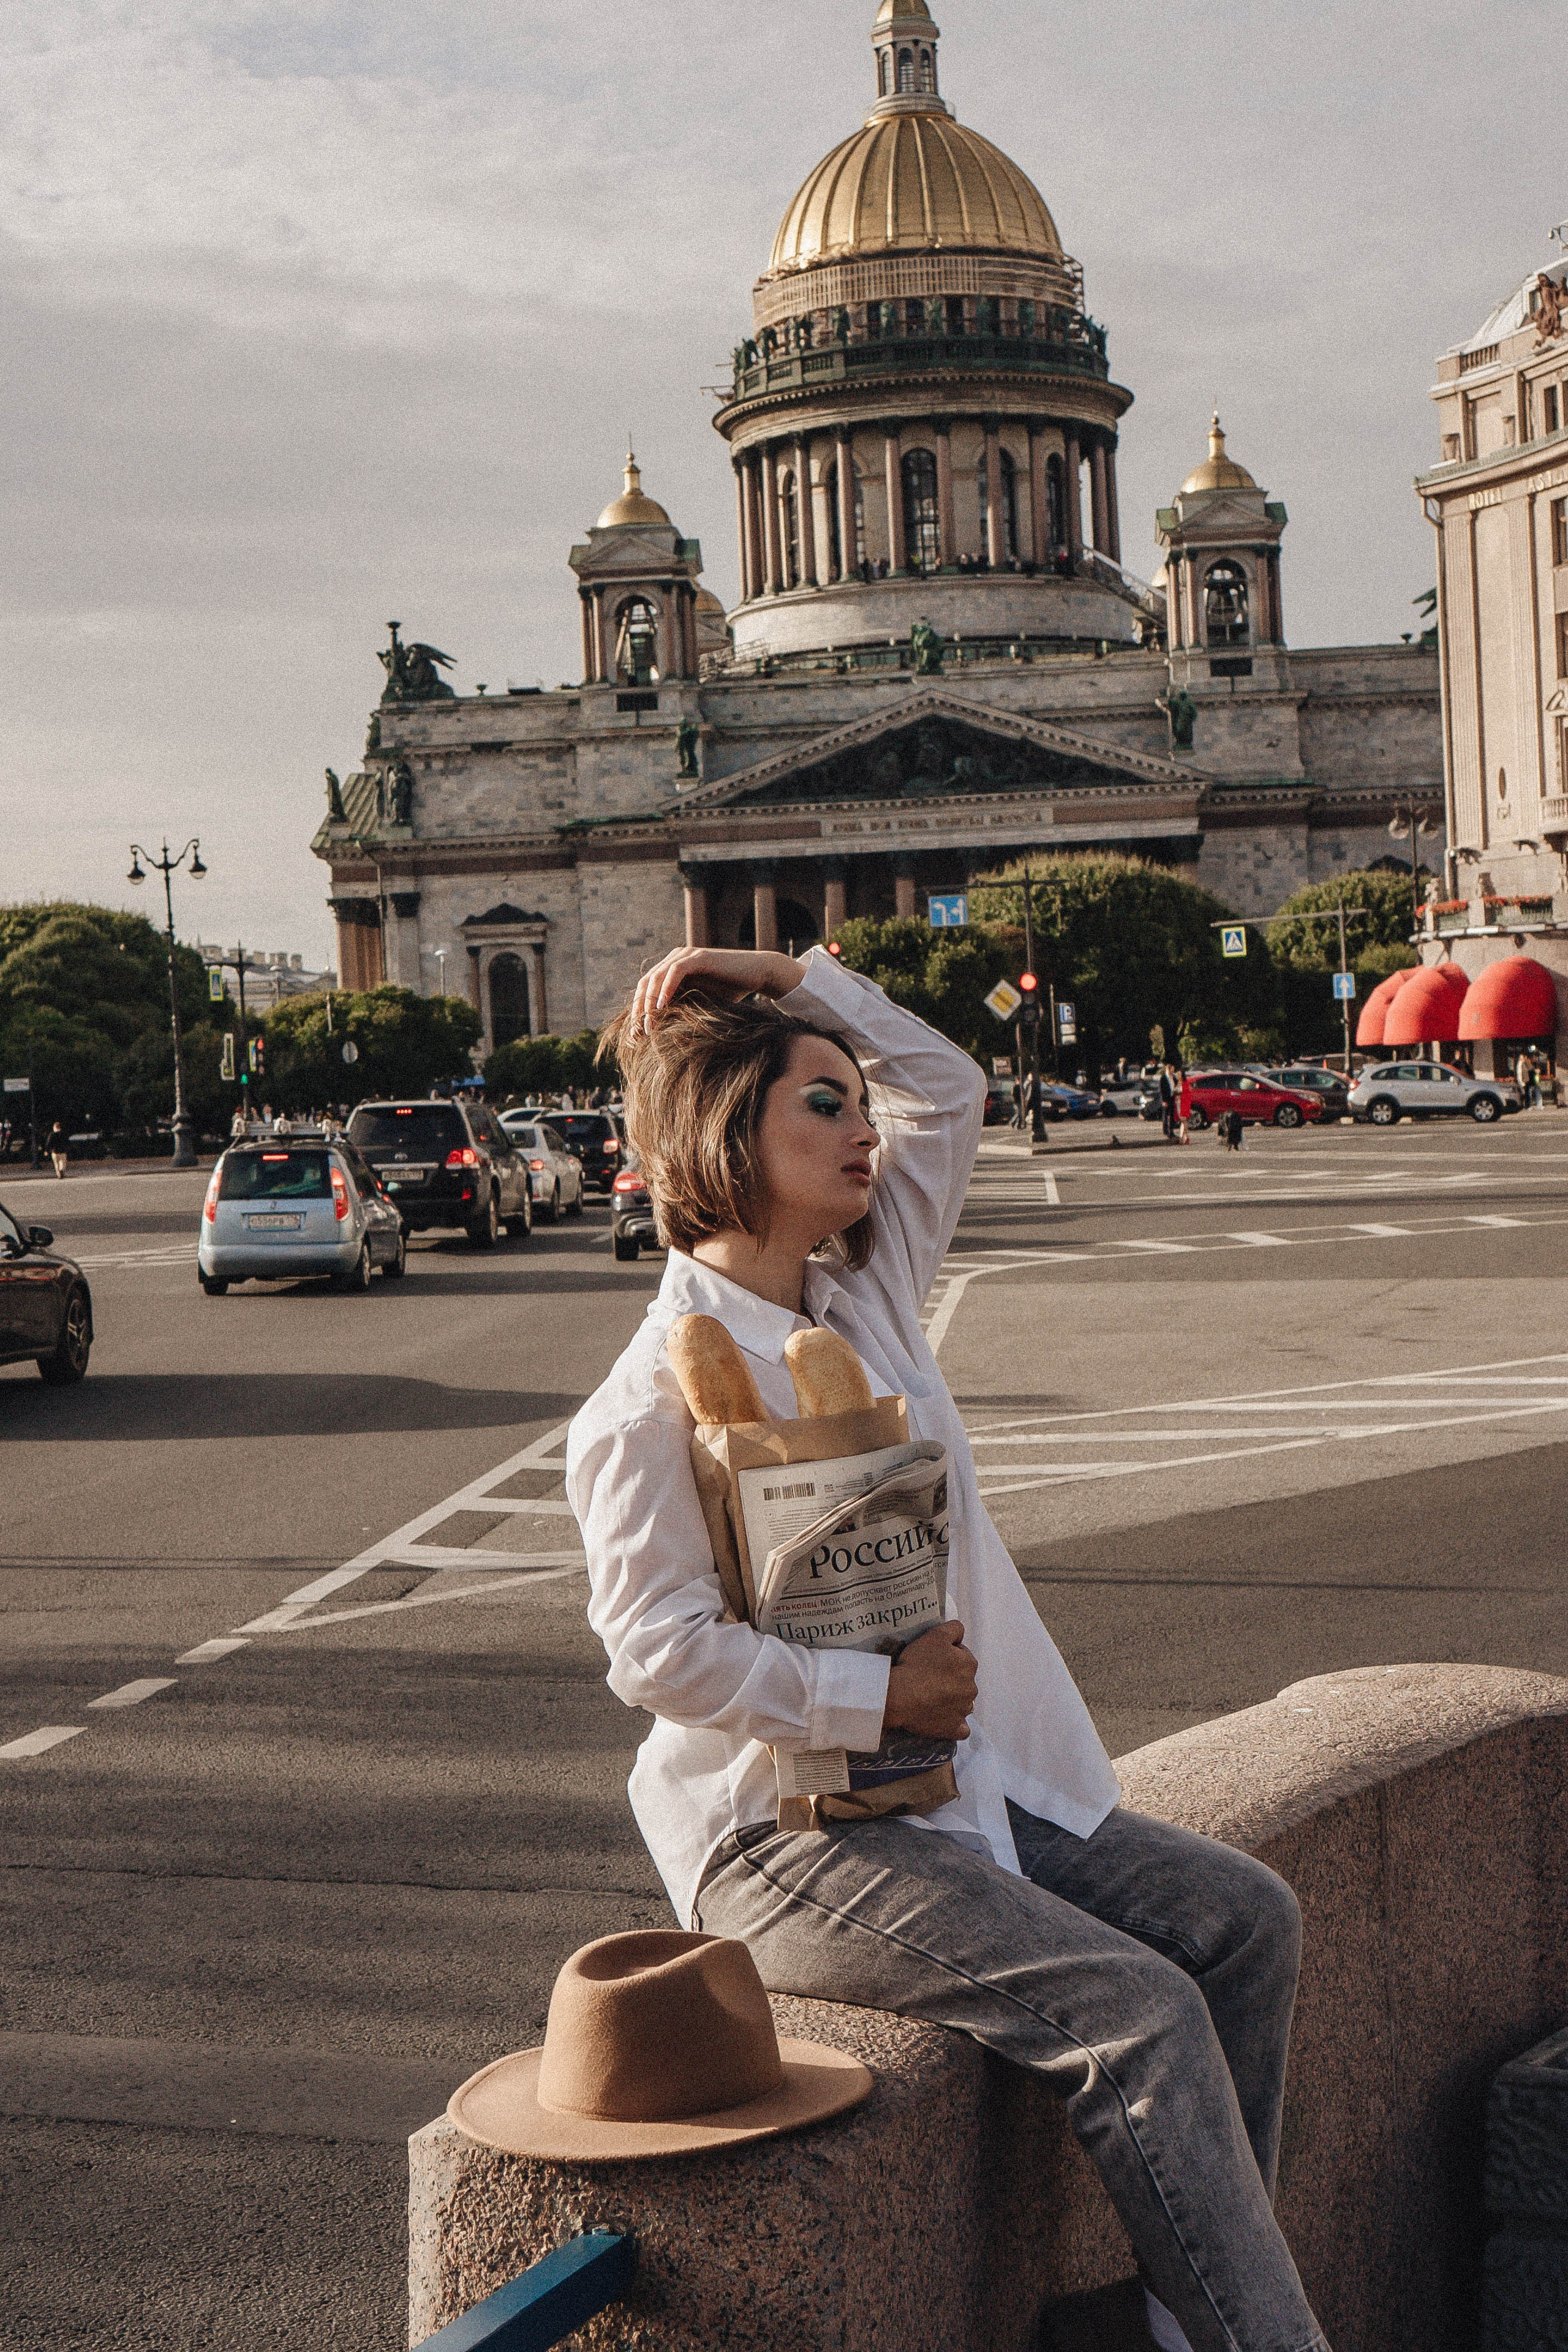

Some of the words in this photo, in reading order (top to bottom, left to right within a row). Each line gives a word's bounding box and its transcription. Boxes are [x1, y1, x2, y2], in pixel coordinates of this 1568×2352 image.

[1468, 488, 1502, 510] HOTEL
[792, 1601, 817, 1610] КОЛЕЦ
[820, 1597, 841, 1607] МОК
[851, 1584, 891, 1600] допускает
[893, 1574, 922, 1591] россиян
[772, 1612, 801, 1621] нашим
[802, 1607, 843, 1618] надеждам
[845, 1597, 873, 1611] попасть
[774, 1619, 855, 1644] Париж
[856, 1597, 938, 1630] закрыт...
